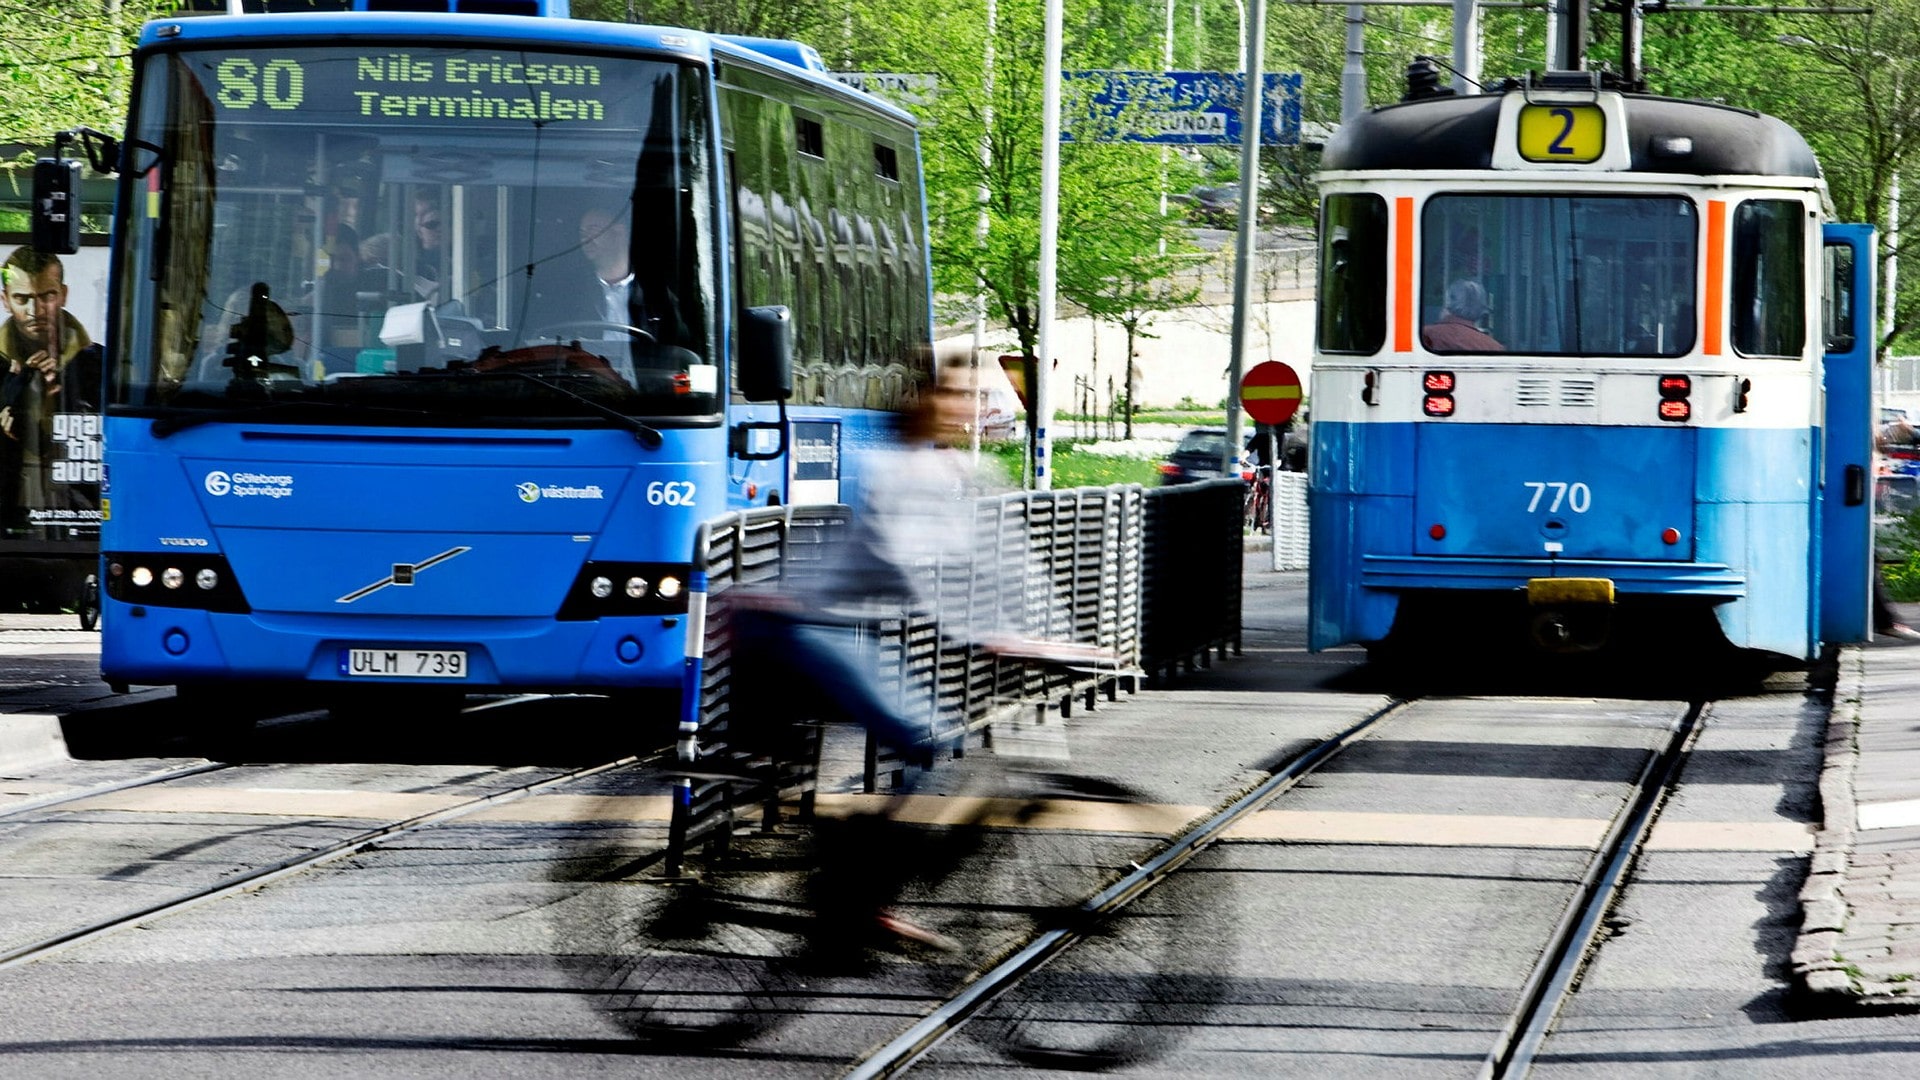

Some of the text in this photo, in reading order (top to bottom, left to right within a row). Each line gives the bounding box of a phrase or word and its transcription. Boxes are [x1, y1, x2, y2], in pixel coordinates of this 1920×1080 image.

[357, 54, 600, 85] Nils Ericson
[217, 58, 304, 110] 80
[354, 90, 604, 120] Terminalen
[1547, 107, 1575, 155] 2
[232, 472, 294, 487] Göteborgs
[232, 484, 294, 499] Spårvägar
[541, 484, 604, 499] västtrafik
[647, 481, 696, 506] 662
[1523, 481, 1591, 514] 770
[28, 509, 54, 520] April
[158, 537, 209, 546] VOLVO
[352, 651, 462, 675] ULM 739
